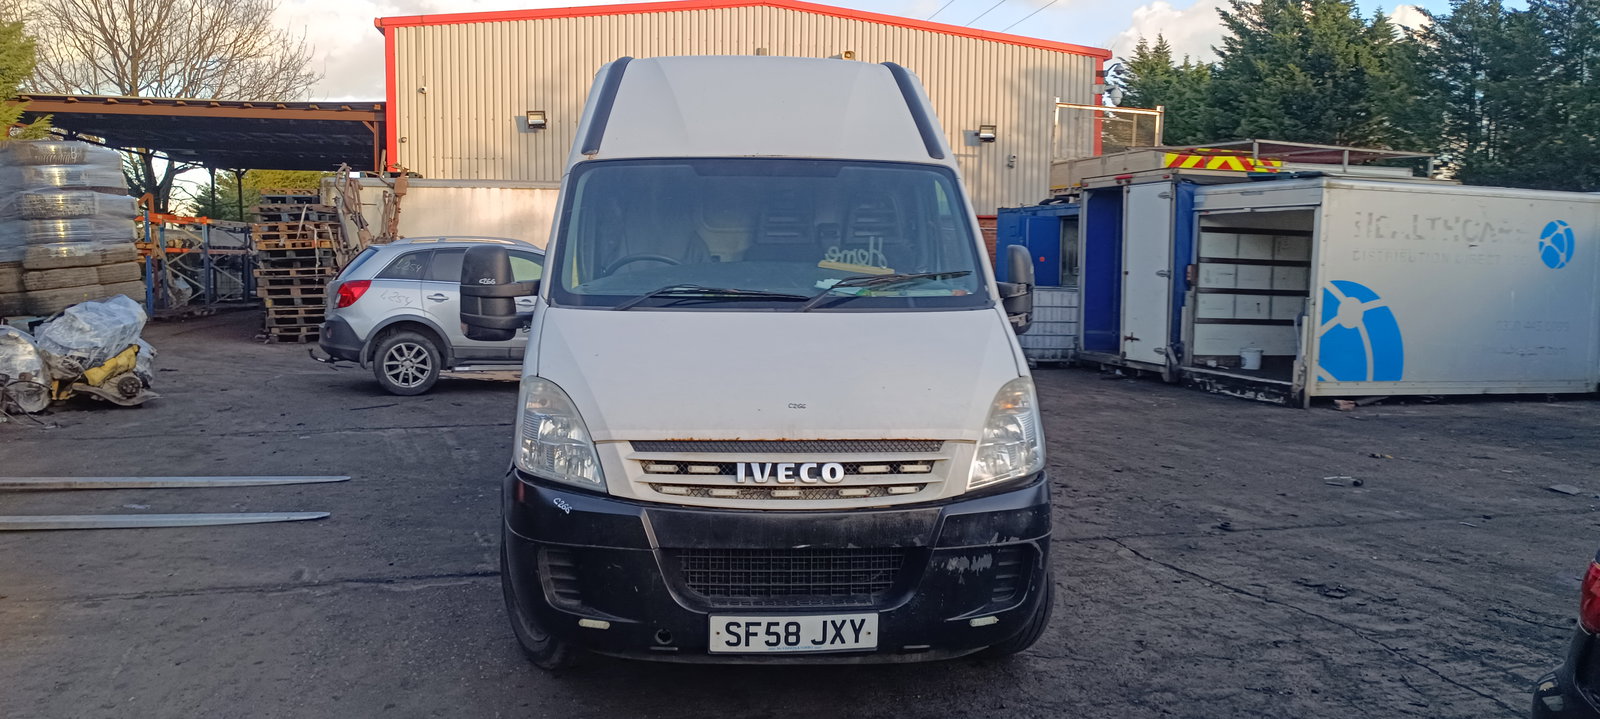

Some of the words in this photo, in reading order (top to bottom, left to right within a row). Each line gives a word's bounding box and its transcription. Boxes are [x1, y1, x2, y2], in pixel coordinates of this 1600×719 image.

[736, 461, 846, 485] IVECO
[552, 497, 573, 515] C266
[724, 621, 802, 647] SF58
[810, 618, 867, 646] JXY
